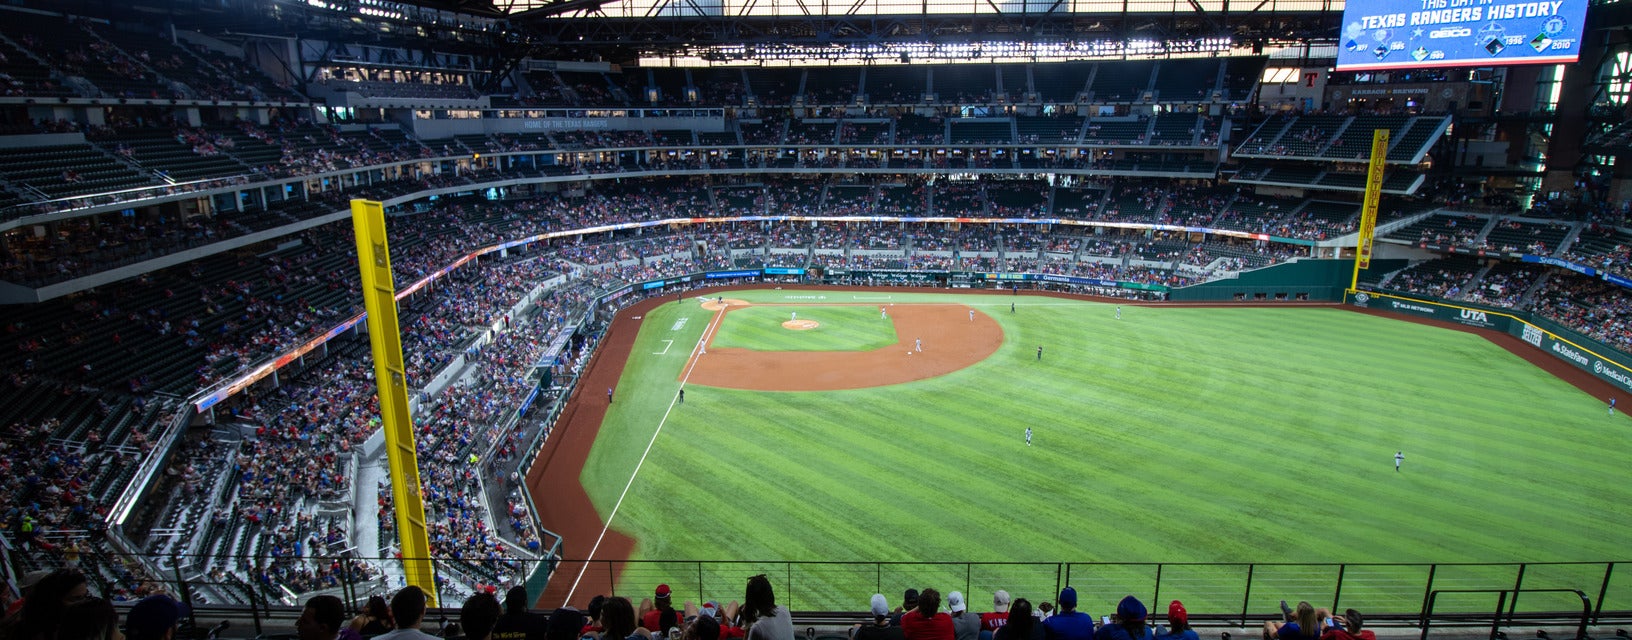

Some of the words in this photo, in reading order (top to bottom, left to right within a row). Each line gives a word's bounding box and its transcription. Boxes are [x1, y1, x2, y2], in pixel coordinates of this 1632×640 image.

[1422, 0, 1447, 9] THIS
[1362, 14, 1406, 30] TEXAS
[1410, 7, 1482, 26] RANGERS
[1488, 1, 1562, 20] HISTORY
[1429, 28, 1472, 38] GEICO
[1552, 42, 1570, 50] 2010
[1304, 71, 1320, 88] T
[524, 120, 541, 128] HOME
[564, 120, 581, 128] TEXAS
[1411, 305, 1434, 313] NETWORK
[1460, 309, 1488, 322] UTA
